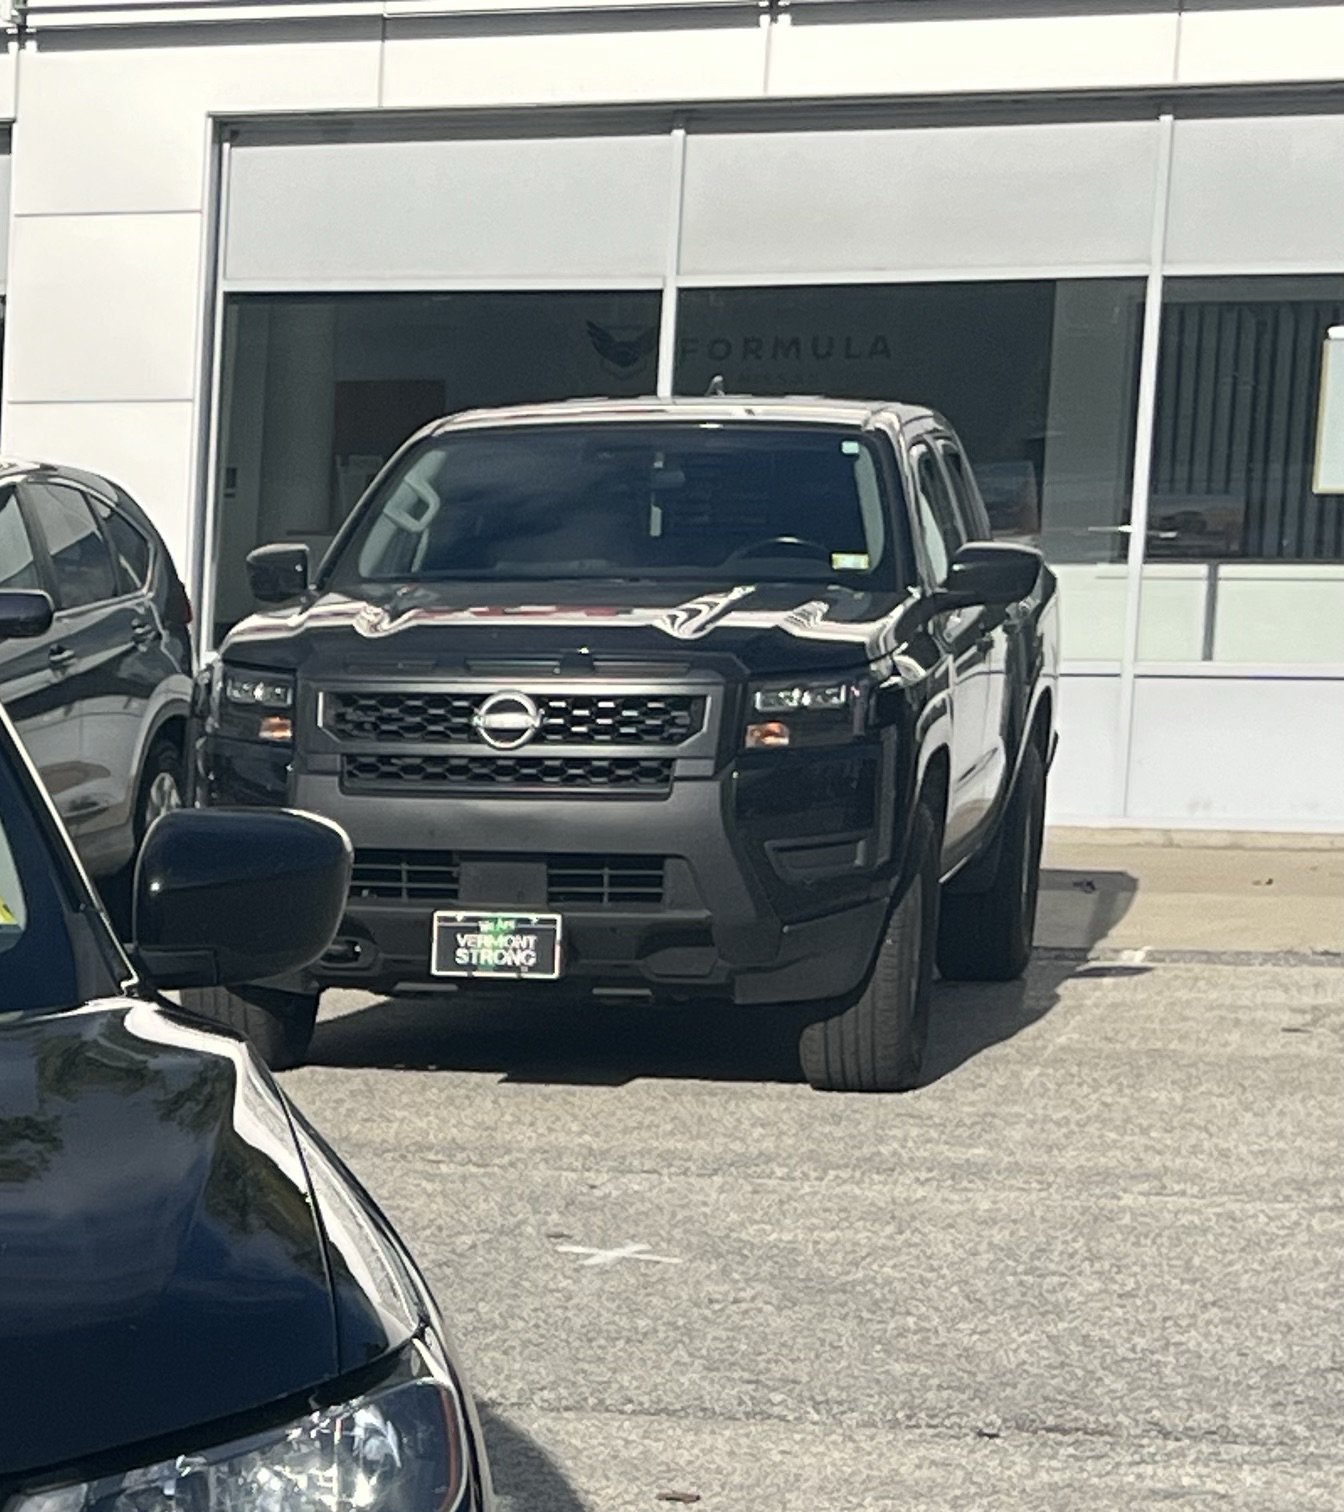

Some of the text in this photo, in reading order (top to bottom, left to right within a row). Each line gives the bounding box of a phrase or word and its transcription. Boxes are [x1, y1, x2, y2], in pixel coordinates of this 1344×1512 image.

[678, 334, 893, 363] FORMULA
[455, 932, 538, 949] VERMONT
[454, 947, 537, 966] STRONG
